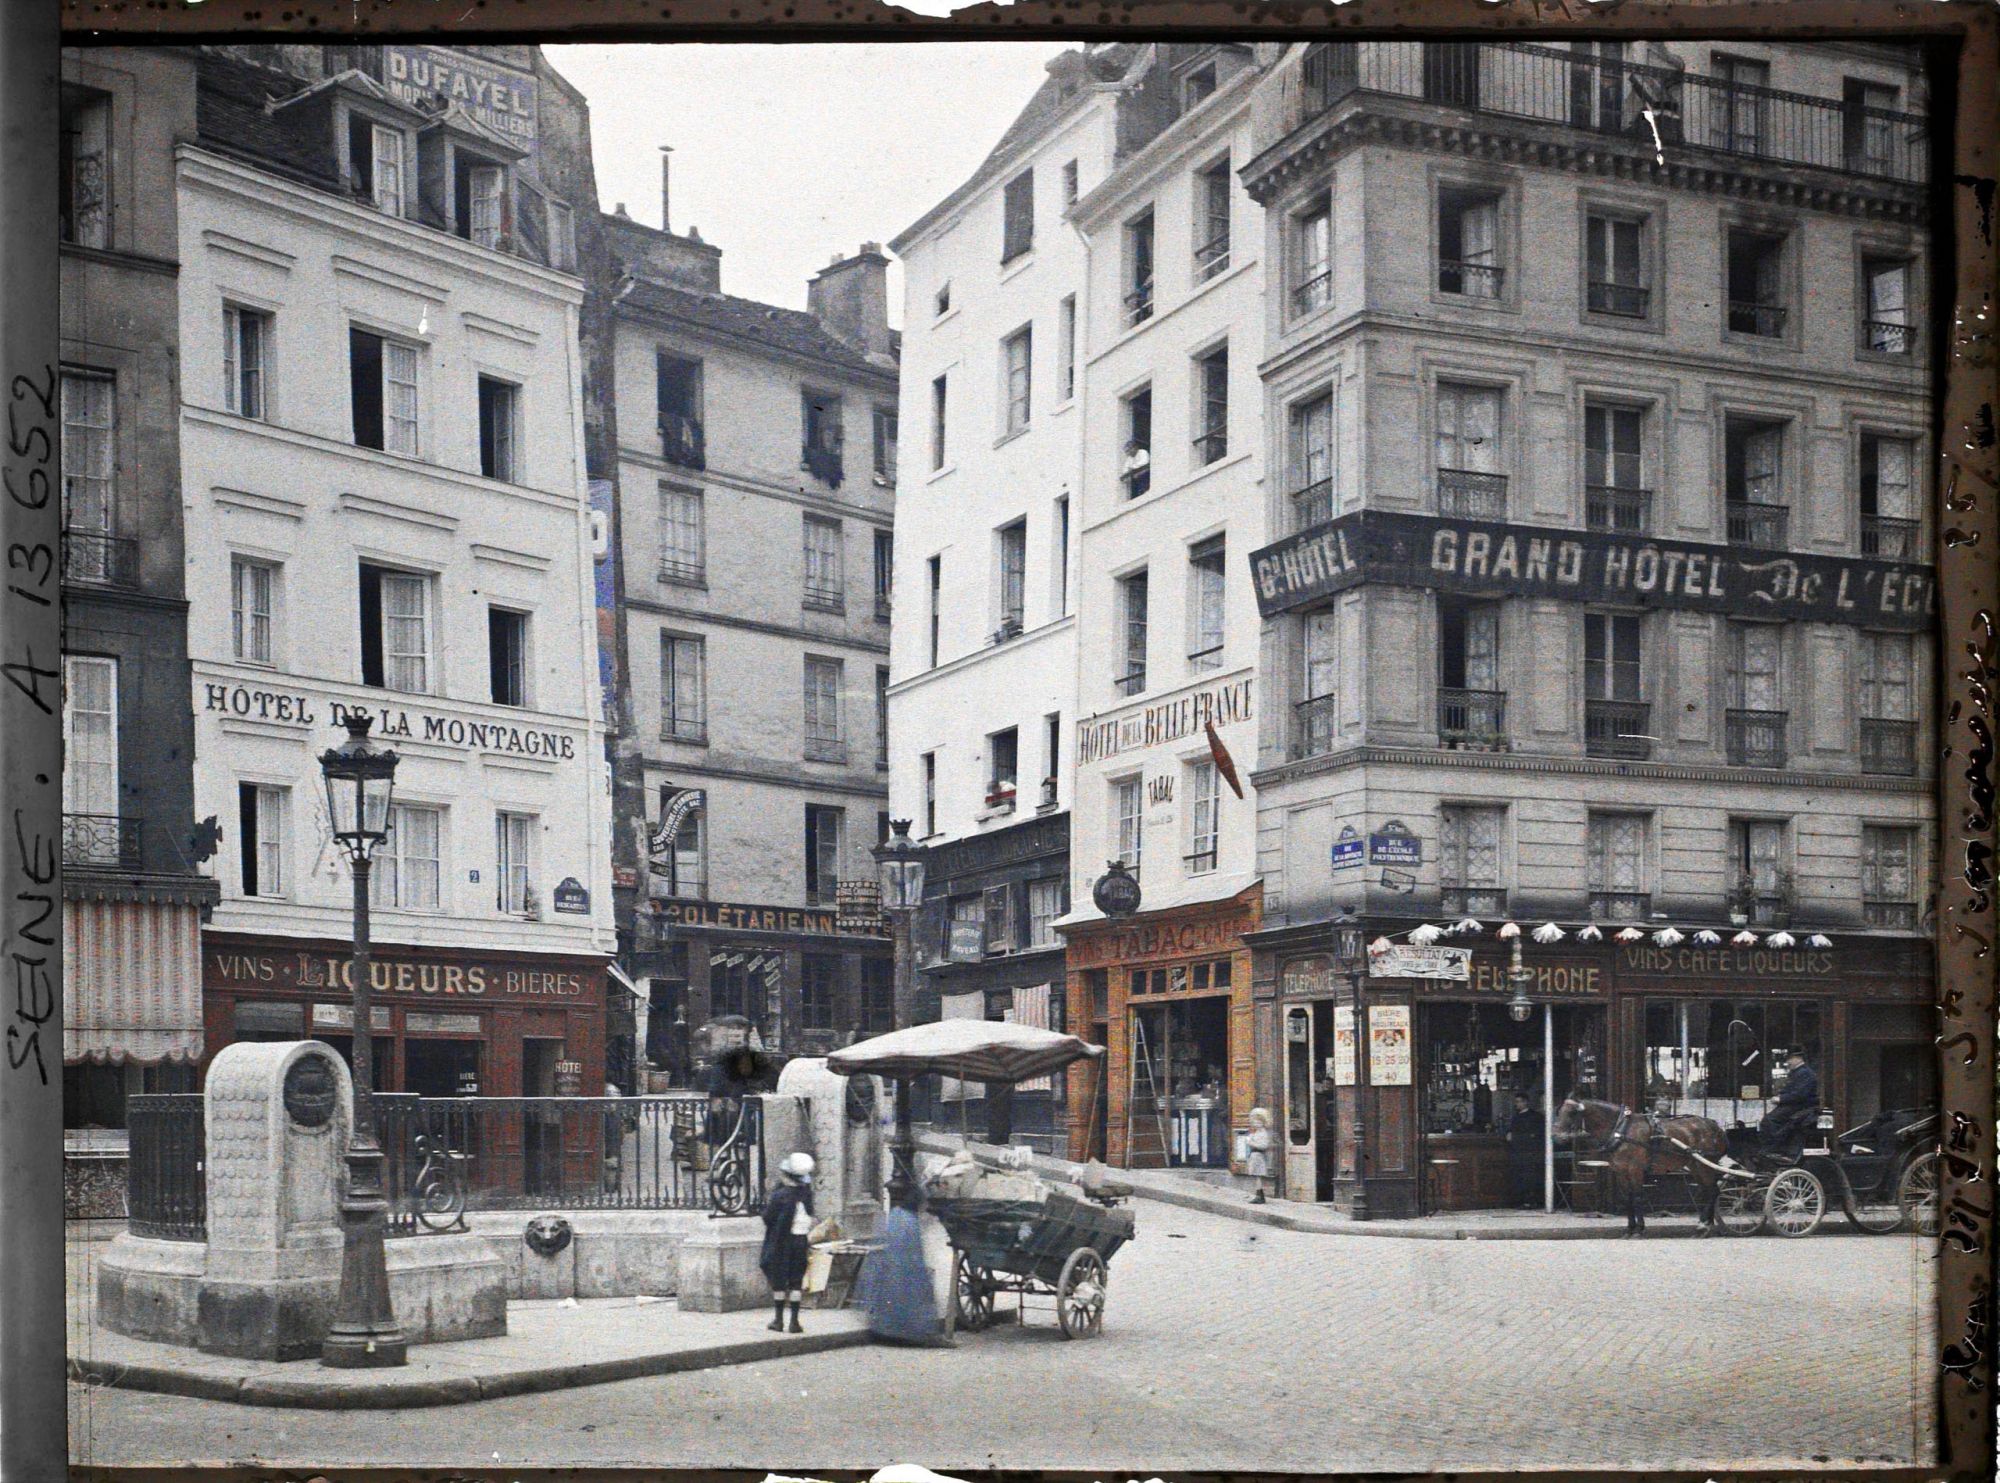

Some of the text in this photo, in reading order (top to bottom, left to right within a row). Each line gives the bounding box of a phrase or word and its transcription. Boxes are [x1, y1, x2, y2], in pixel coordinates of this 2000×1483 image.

[389, 51, 529, 117] DUFAYEL
[1282, 528, 1357, 591] HÔTEL
[1431, 529, 1584, 585] GRAND
[1604, 543, 1725, 598] HÔTEL
[0, 362, 59, 1087] SEINE A 13 652
[206, 684, 314, 724] HÔTEL
[380, 708, 412, 738] LA
[423, 716, 575, 760] MONTAGNE
[1145, 697, 1190, 748] BELLE
[1193, 678, 1253, 732] FRANCE
[471, 870, 479, 882] 2
[1110, 923, 1196, 958] TABAC
[1625, 949, 1673, 971] VINS
[1736, 950, 1834, 975] LIQUEURS
[216, 954, 275, 981] VINS
[506, 971, 581, 996] BIERES
